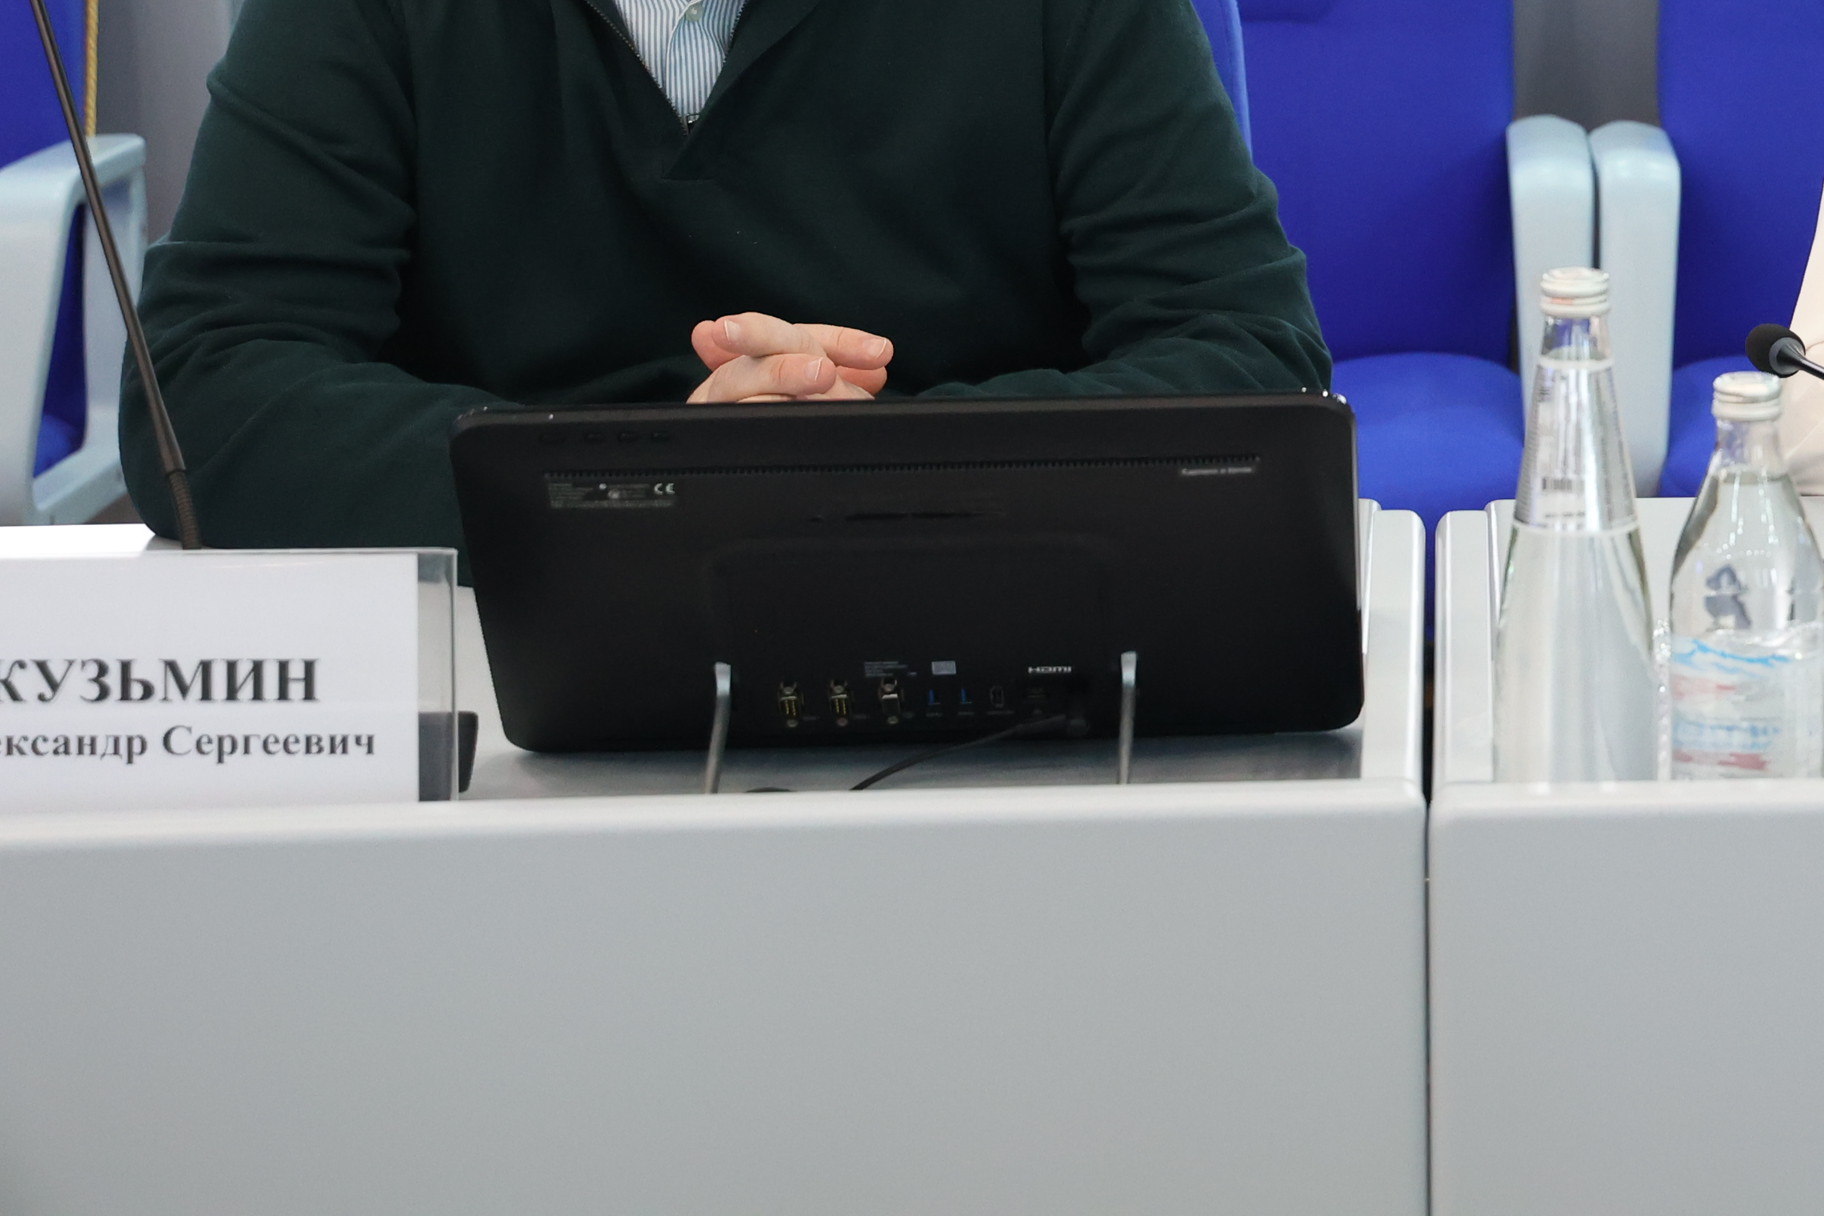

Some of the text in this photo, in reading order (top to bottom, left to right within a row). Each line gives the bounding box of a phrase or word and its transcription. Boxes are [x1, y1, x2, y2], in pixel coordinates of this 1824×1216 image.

[0, 658, 319, 704] КУЗЬМИН
[0, 725, 376, 765] ксандр Сергеевич
